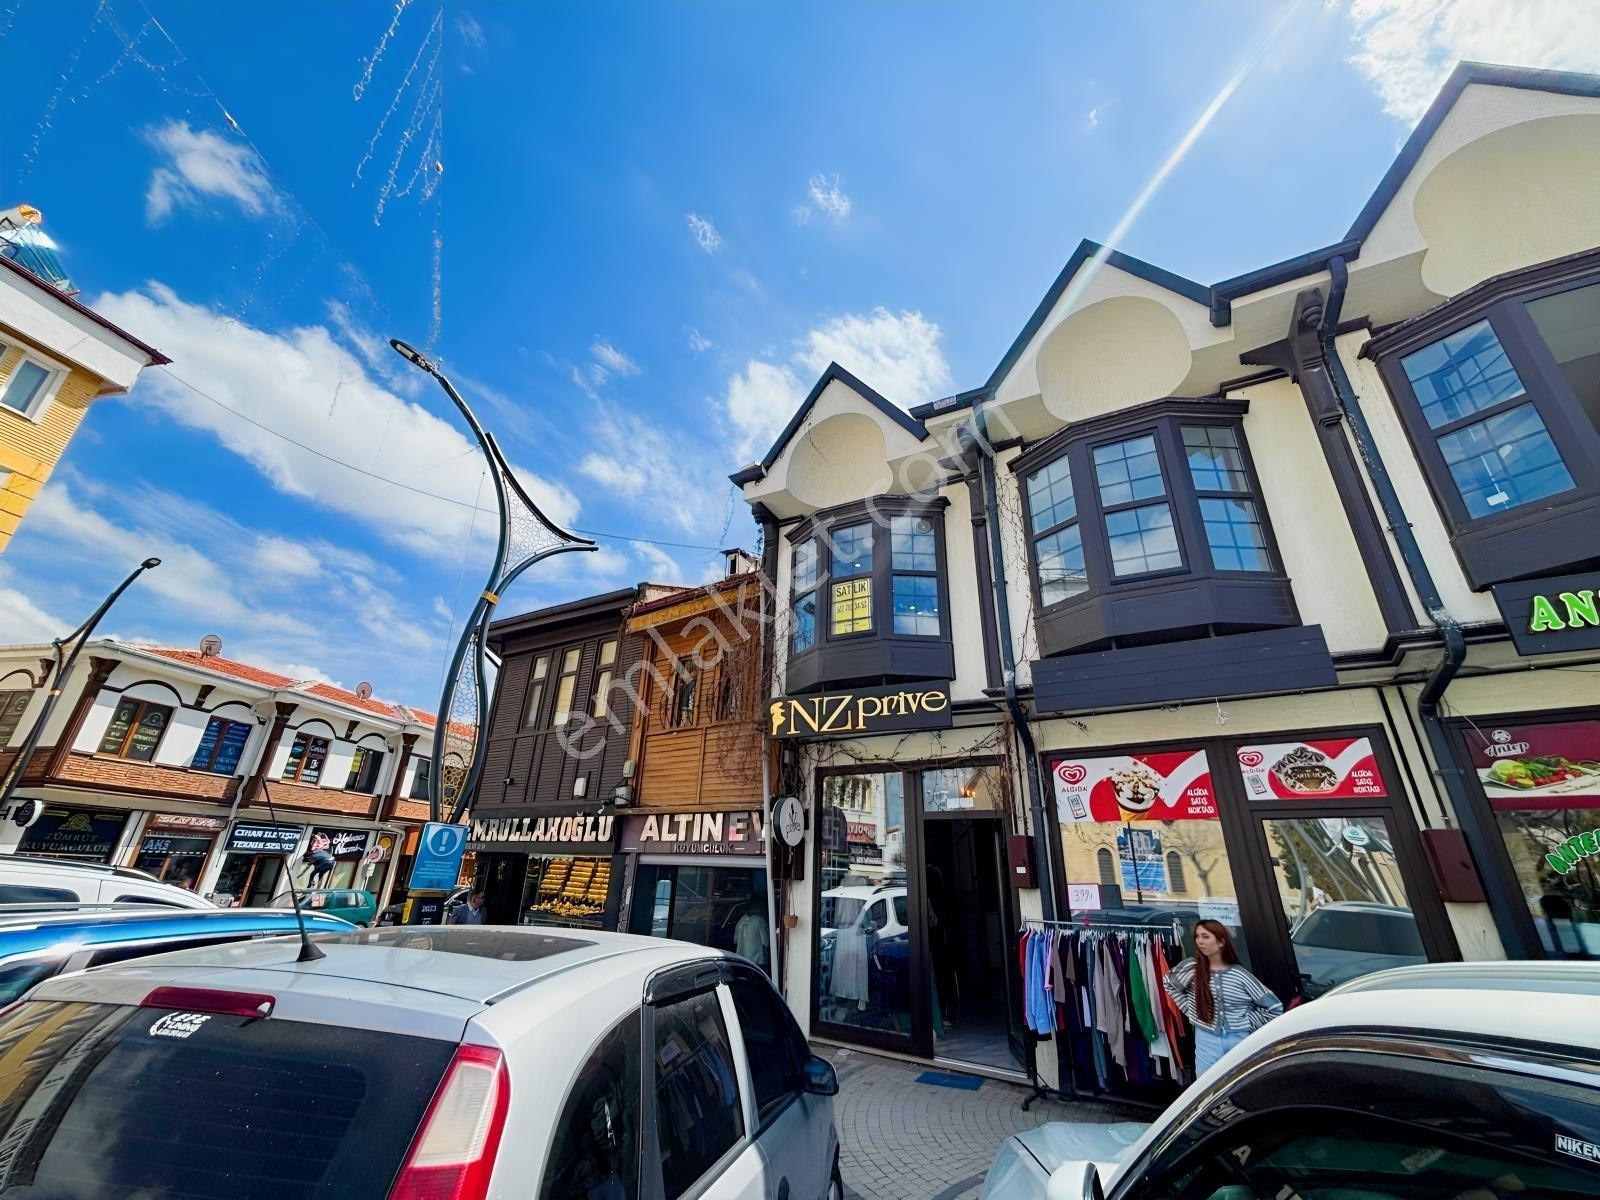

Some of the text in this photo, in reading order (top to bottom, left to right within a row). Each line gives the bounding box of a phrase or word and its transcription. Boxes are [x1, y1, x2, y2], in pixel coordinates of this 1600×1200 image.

[836, 581, 866, 597] SATLIK
[1531, 590, 1600, 631] AN
[640, 812, 724, 842] ALTIN
[1545, 828, 1600, 875] ANTE
